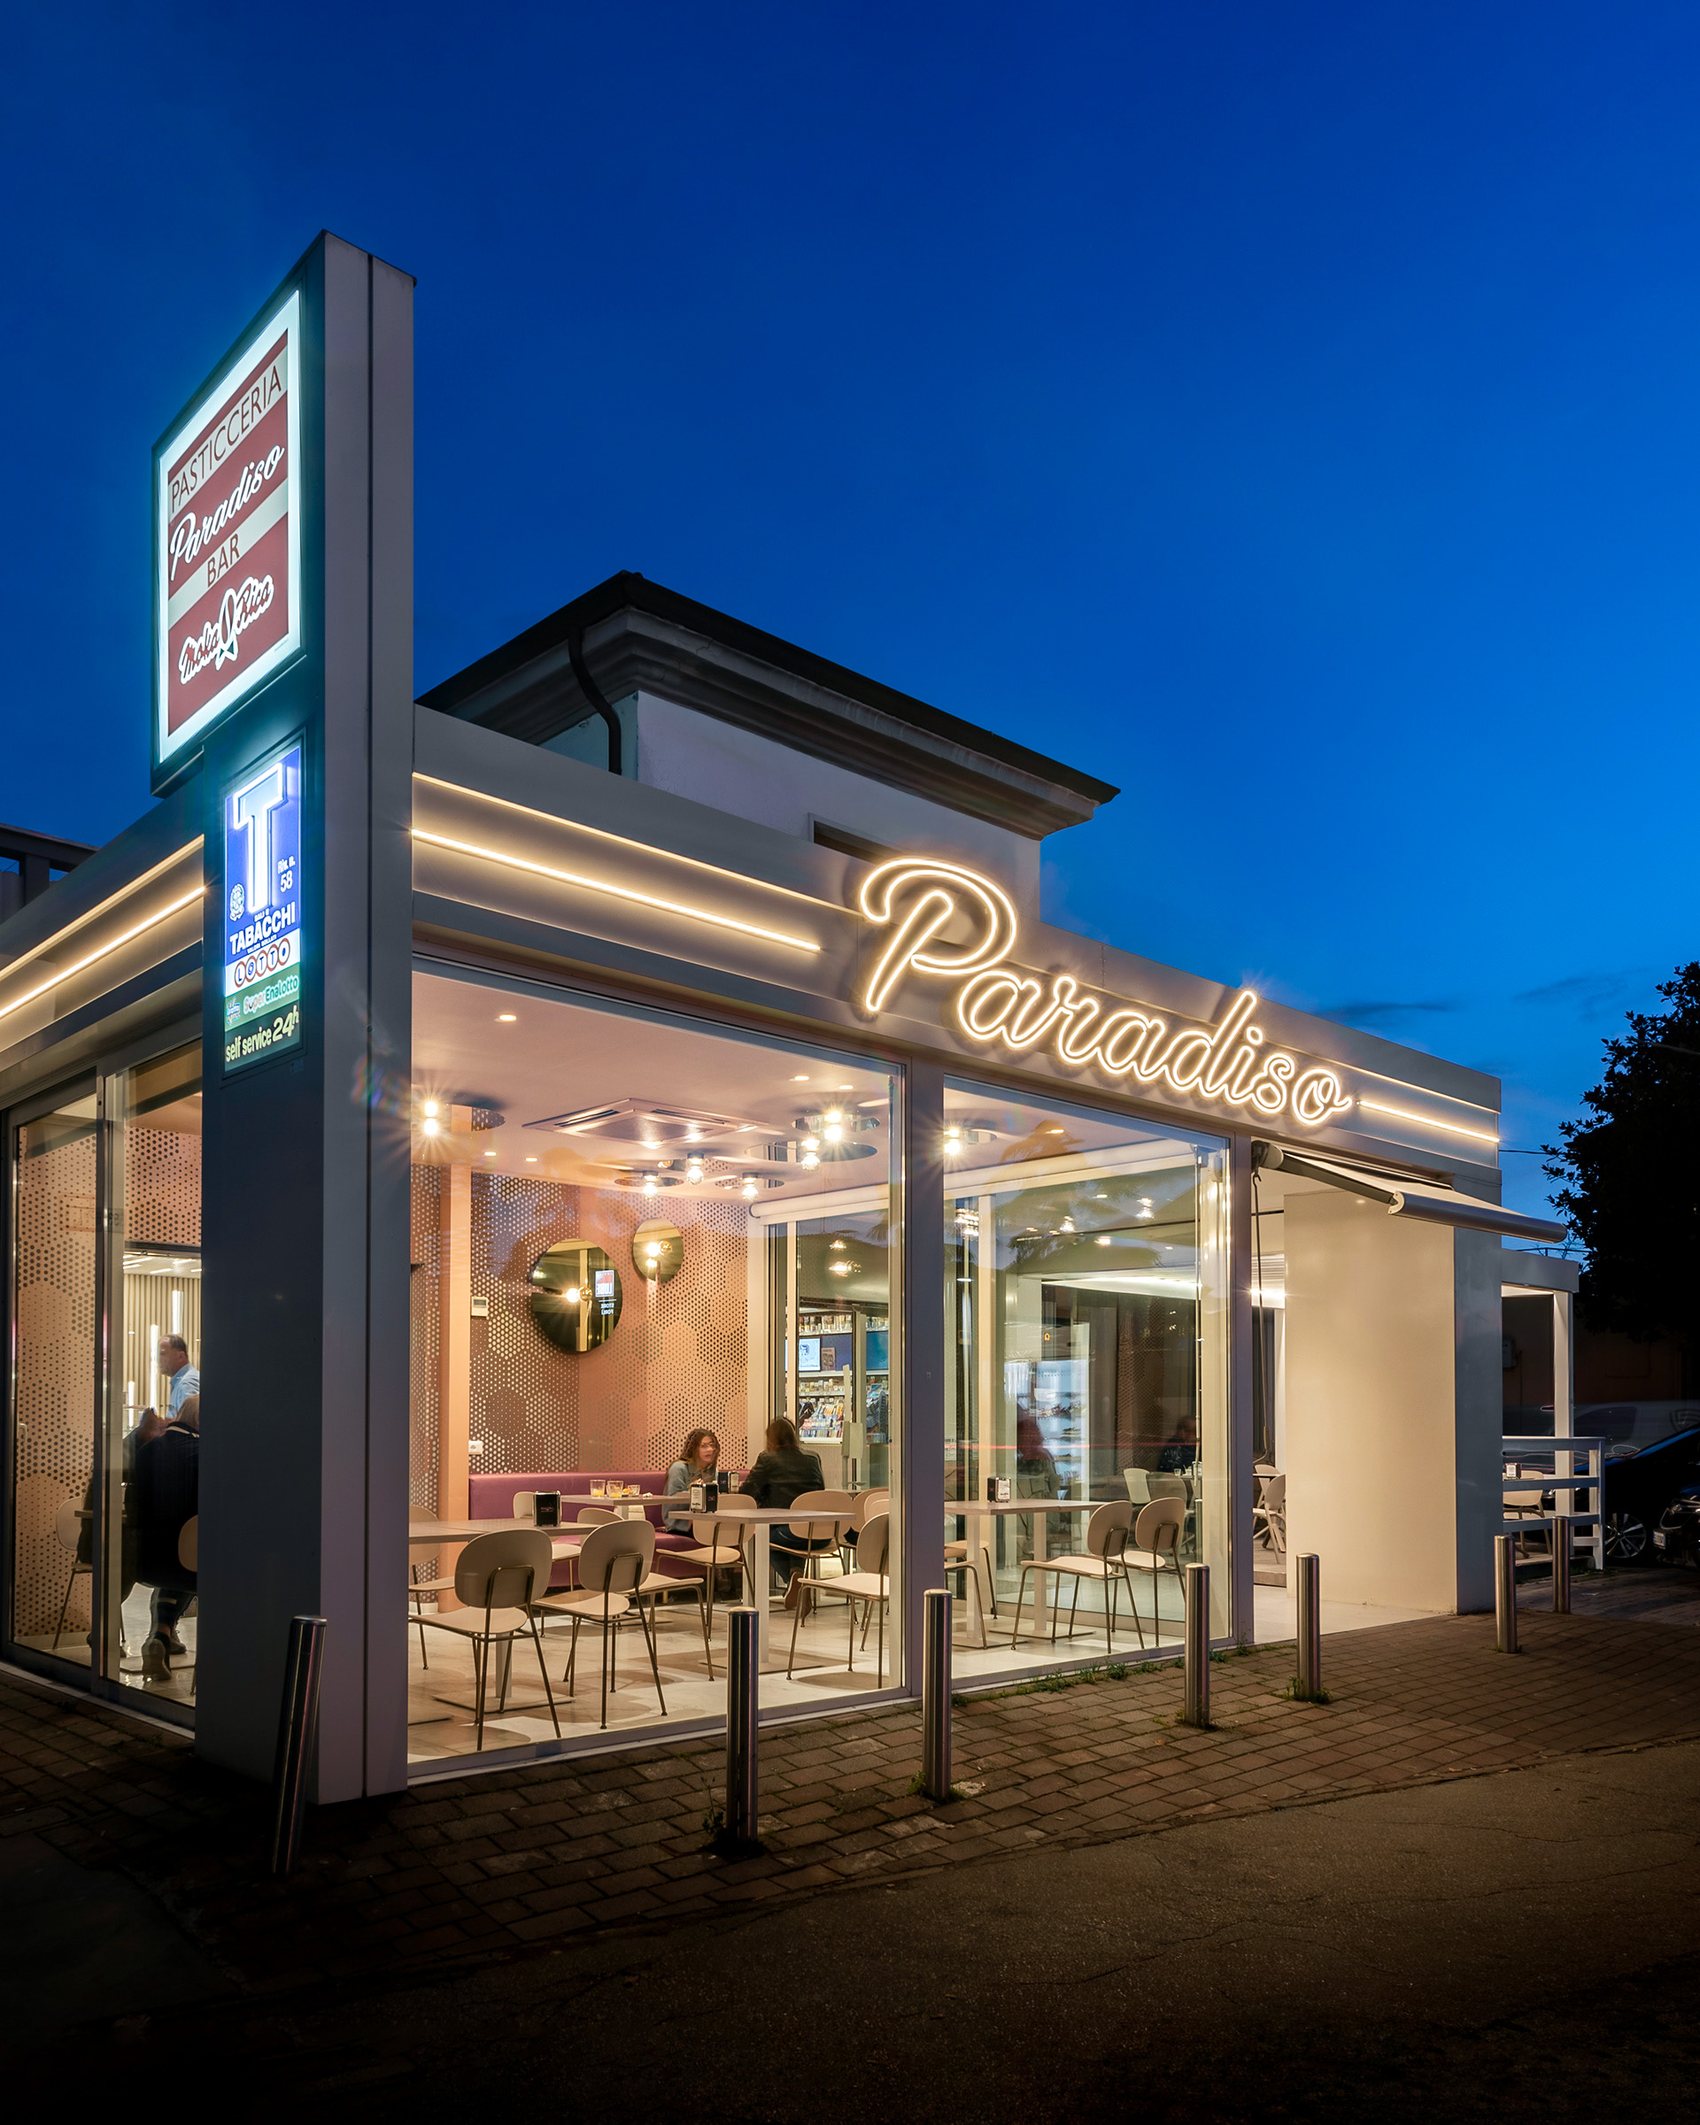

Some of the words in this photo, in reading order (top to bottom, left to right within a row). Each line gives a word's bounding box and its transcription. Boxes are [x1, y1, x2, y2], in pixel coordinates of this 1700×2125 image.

[171, 365, 282, 514] PASTICCERIA
[170, 445, 285, 581] Paradiso
[208, 533, 240, 588] BAR
[233, 762, 288, 913] T
[280, 870, 293, 892] 58
[230, 901, 296, 955] TABACCHI
[235, 940, 289, 986] LOTTO
[860, 857, 1352, 1126] Paradiso
[226, 1036, 241, 1062] self
[242, 1027, 272, 1055] service
[272, 1005, 299, 1042] 24h
